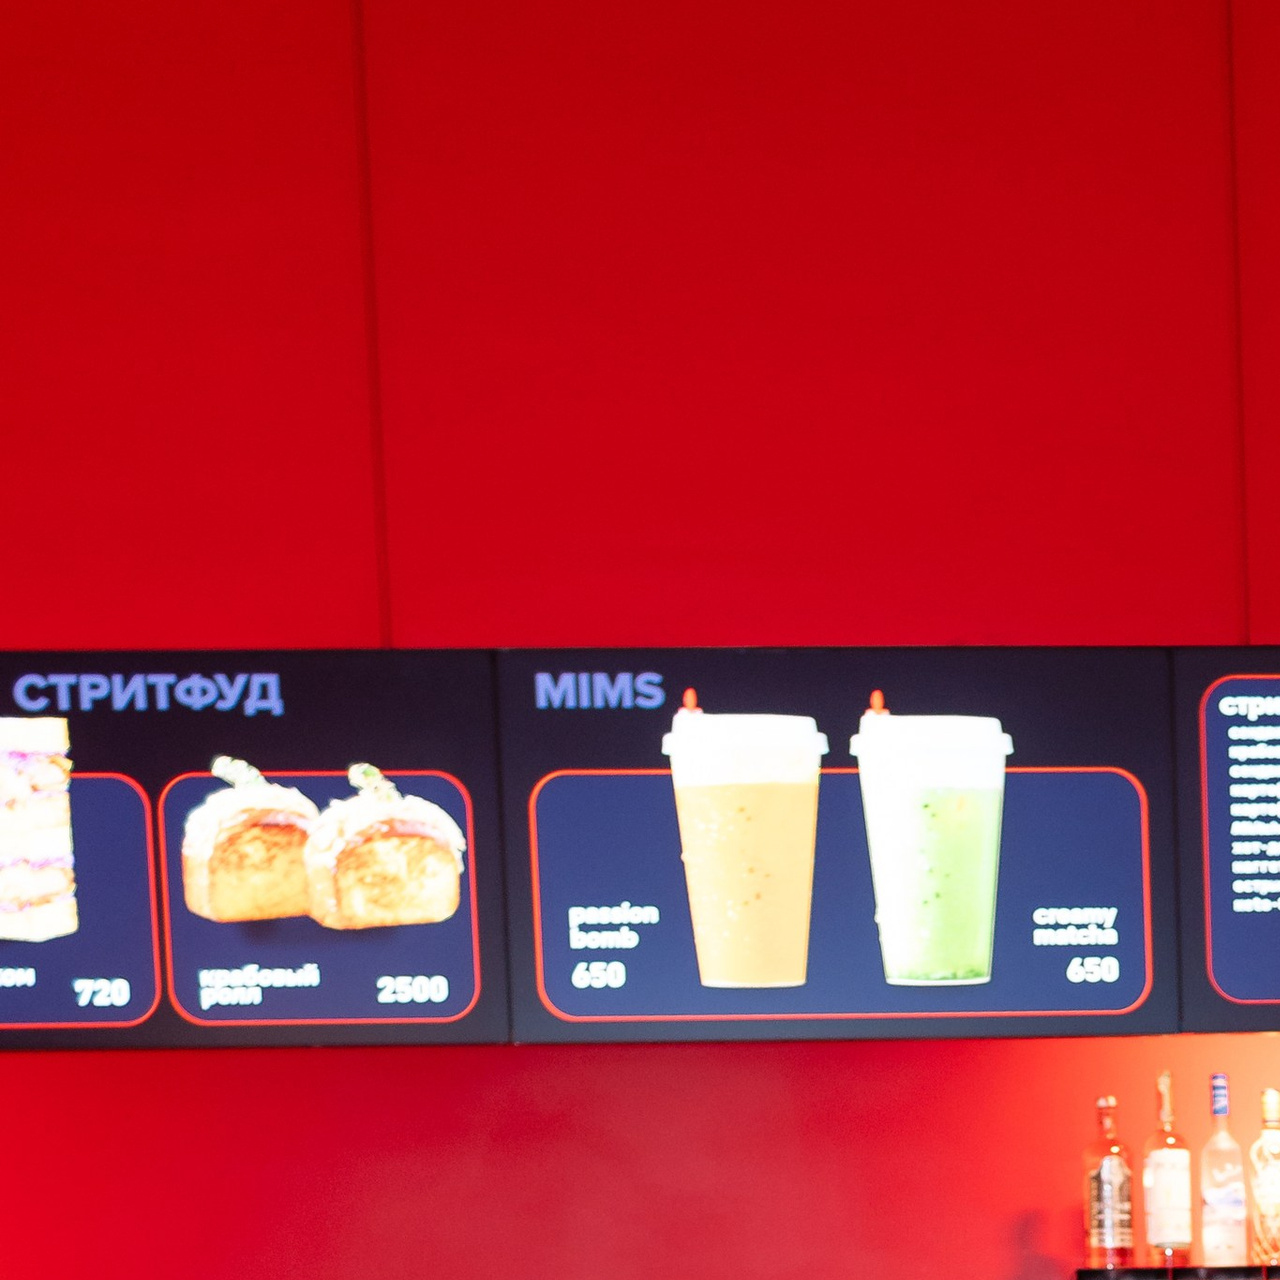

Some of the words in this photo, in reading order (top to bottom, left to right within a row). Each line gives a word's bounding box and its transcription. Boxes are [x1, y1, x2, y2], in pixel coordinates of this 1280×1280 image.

[13, 673, 284, 716] СТРИТФУД
[535, 672, 665, 709] MIMS
[568, 901, 660, 928] passion
[1032, 906, 1119, 930] creamy
[569, 926, 640, 950] bomb
[1032, 925, 1119, 947] matcha
[198, 962, 322, 988] крабовый
[571, 961, 627, 989] 650
[1066, 956, 1120, 983] 650
[73, 978, 131, 1007] 720
[376, 975, 449, 1004] 2500
